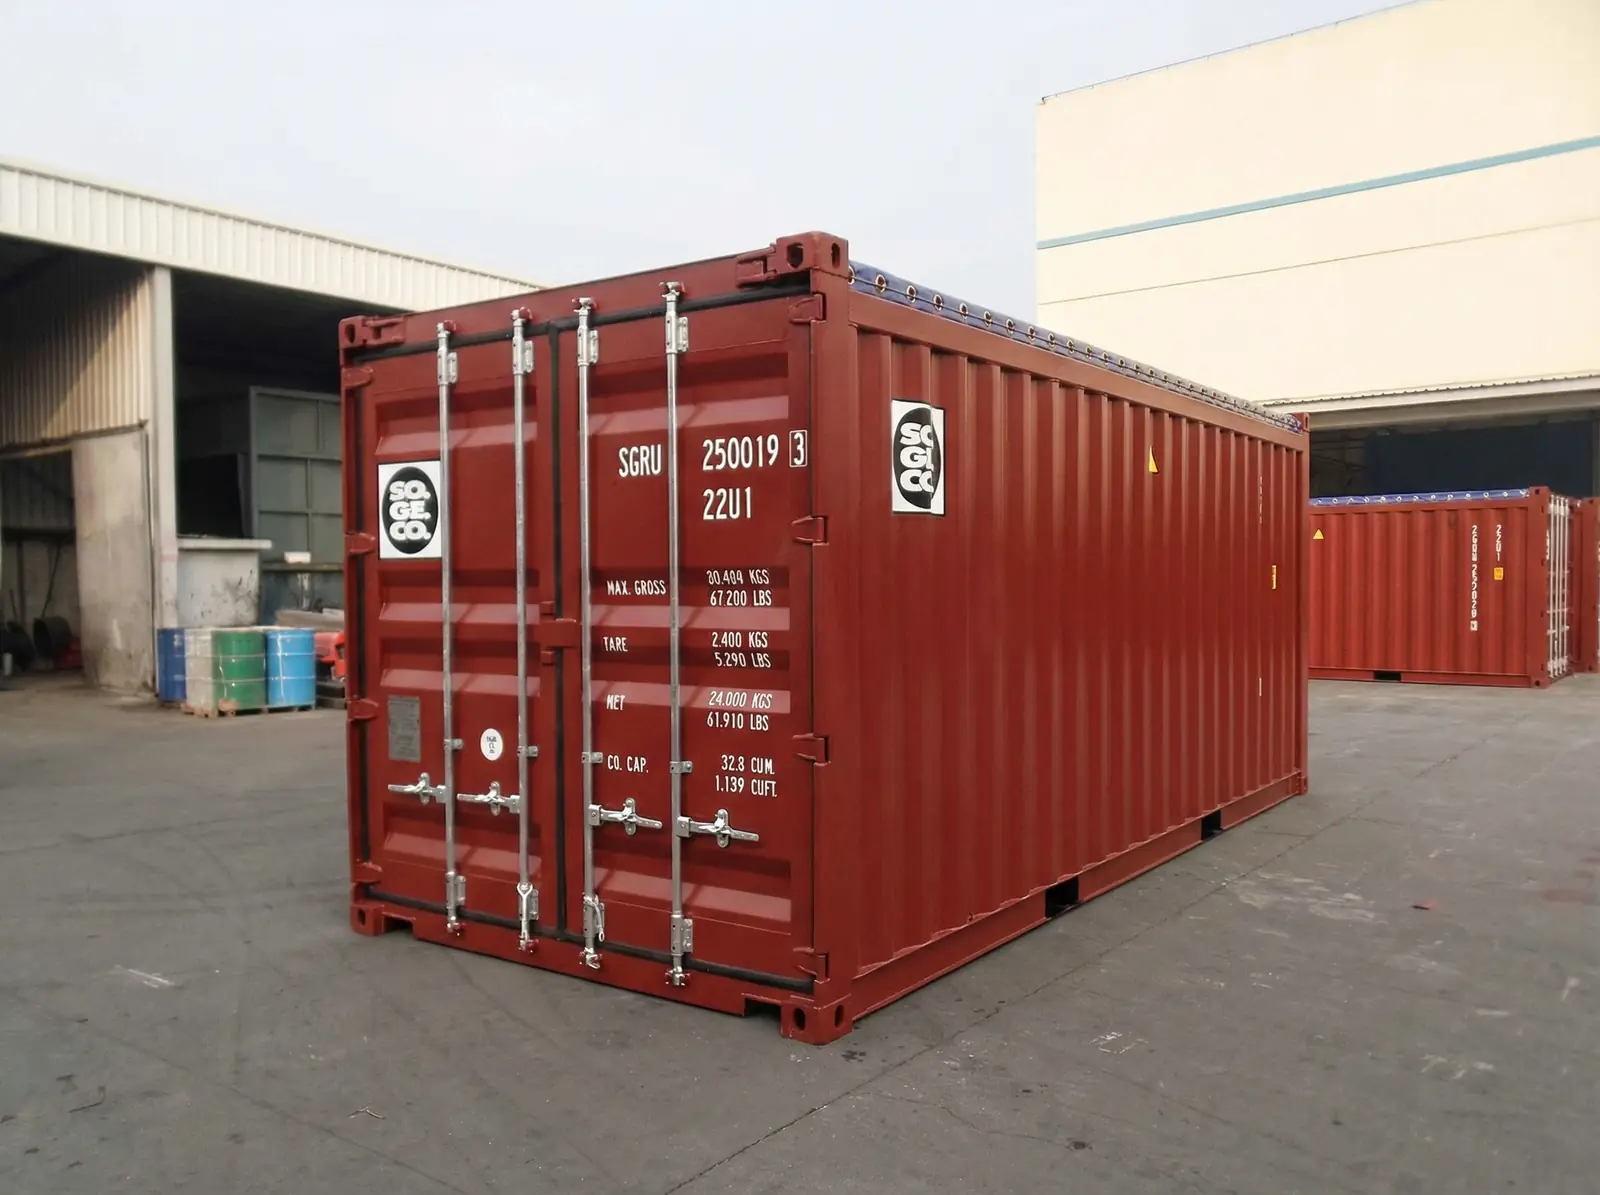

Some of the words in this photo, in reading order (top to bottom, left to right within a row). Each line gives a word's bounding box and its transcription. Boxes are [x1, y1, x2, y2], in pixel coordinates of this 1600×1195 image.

[618, 443, 662, 478] SGRU
[702, 433, 779, 471] 250019
[791, 430, 806, 467] 3
[702, 486, 752, 520] 22U1
[748, 569, 770, 585] KGS
[606, 580, 631, 596] MAX.
[634, 579, 667, 595] GROSS
[710, 589, 747, 606] 67.200
[752, 589, 772, 606] LBS
[603, 636, 628, 652] TARE
[711, 631, 742, 648] 2.400
[748, 631, 768, 648] KGS
[714, 652, 746, 668] 5.290
[751, 652, 771, 668] LBS
[606, 694, 626, 711] NET
[708, 690, 747, 708] 24.000
[751, 692, 773, 709] KGS
[706, 711, 744, 729] 61.910
[750, 713, 769, 732] LBS
[607, 754, 622, 771] CO.
[627, 756, 649, 774] CAP.
[721, 754, 745, 772] 32.8
[715, 775, 745, 794] 1.139
